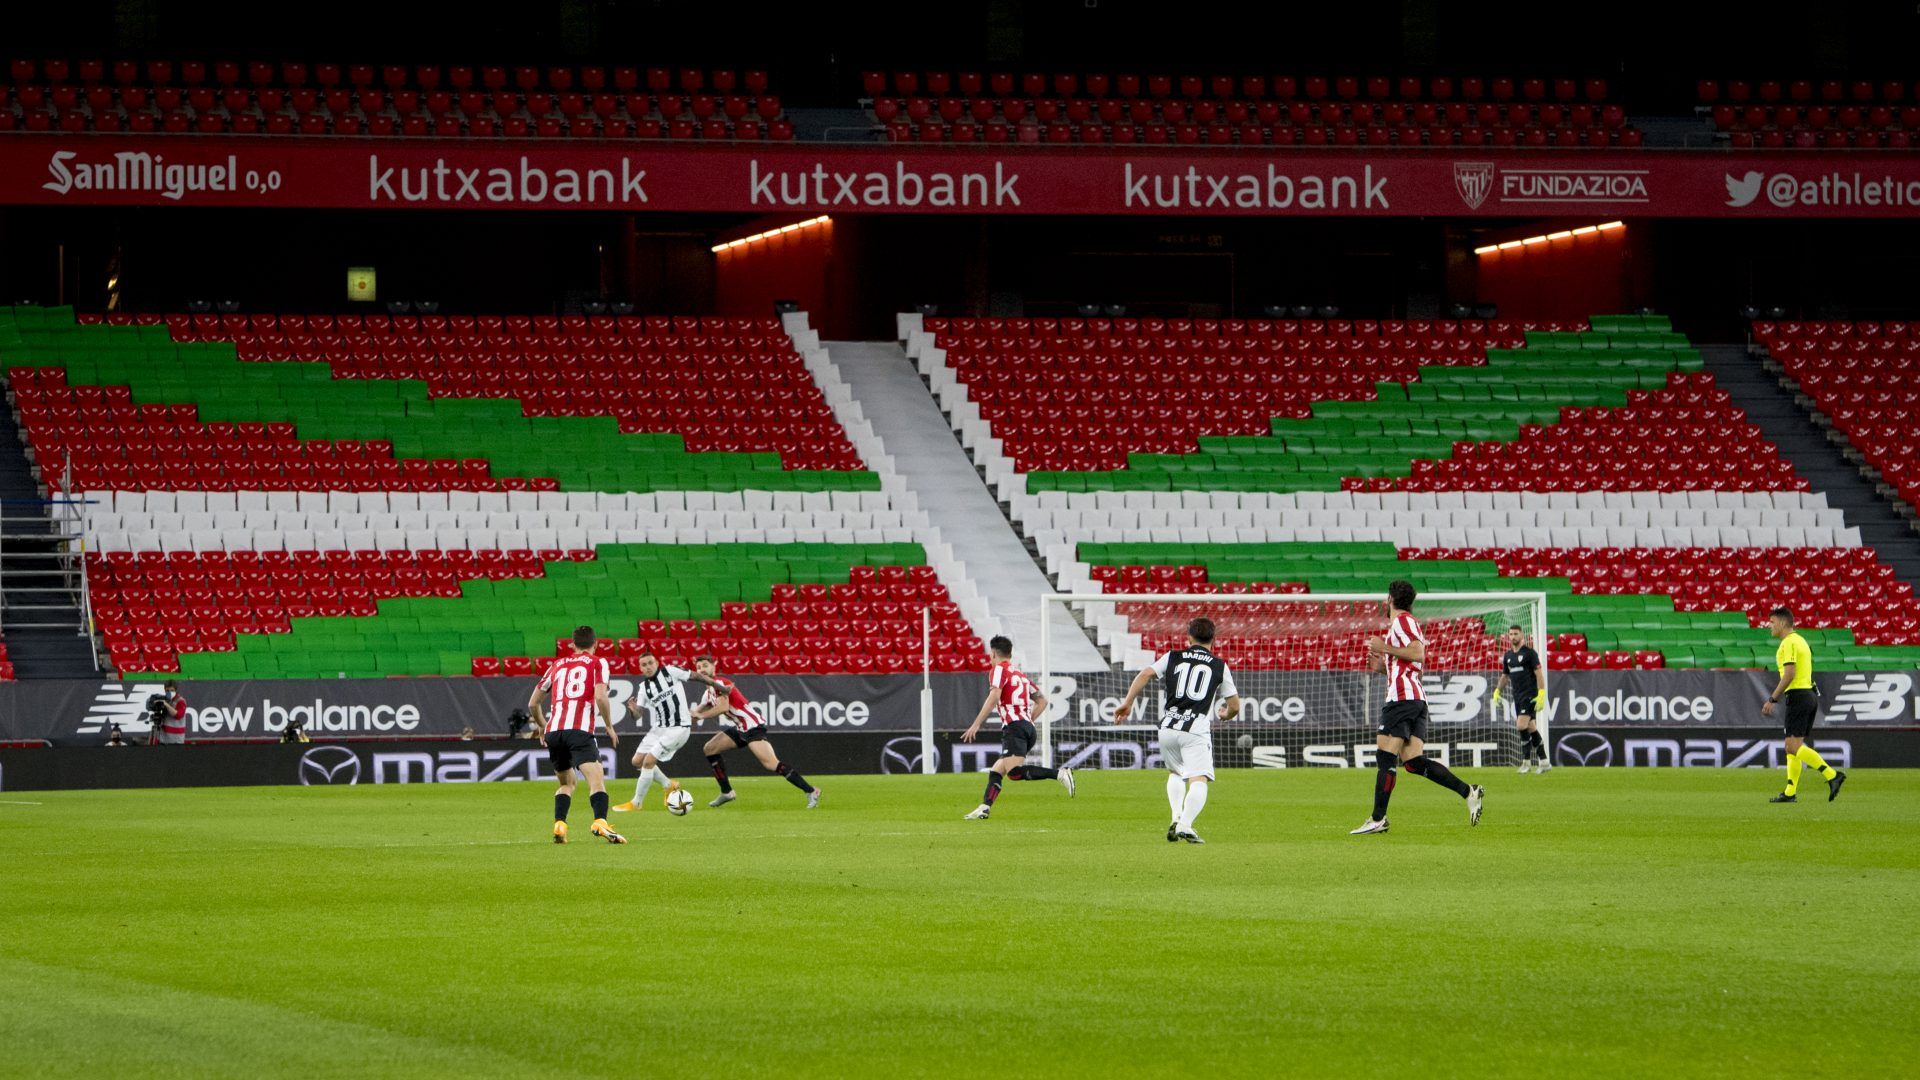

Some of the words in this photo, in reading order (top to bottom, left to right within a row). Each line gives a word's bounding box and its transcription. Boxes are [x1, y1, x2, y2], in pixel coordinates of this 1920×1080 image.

[370, 155, 648, 202] kutxabank
[750, 160, 1020, 206] kutxabank
[1125, 162, 1389, 209] kutxabank
[1502, 176, 1647, 196] FUNDAZIOA
[554, 665, 587, 701] 18
[1173, 662, 1213, 701] 10
[263, 699, 420, 732] balance
[1569, 689, 1714, 721] balance
